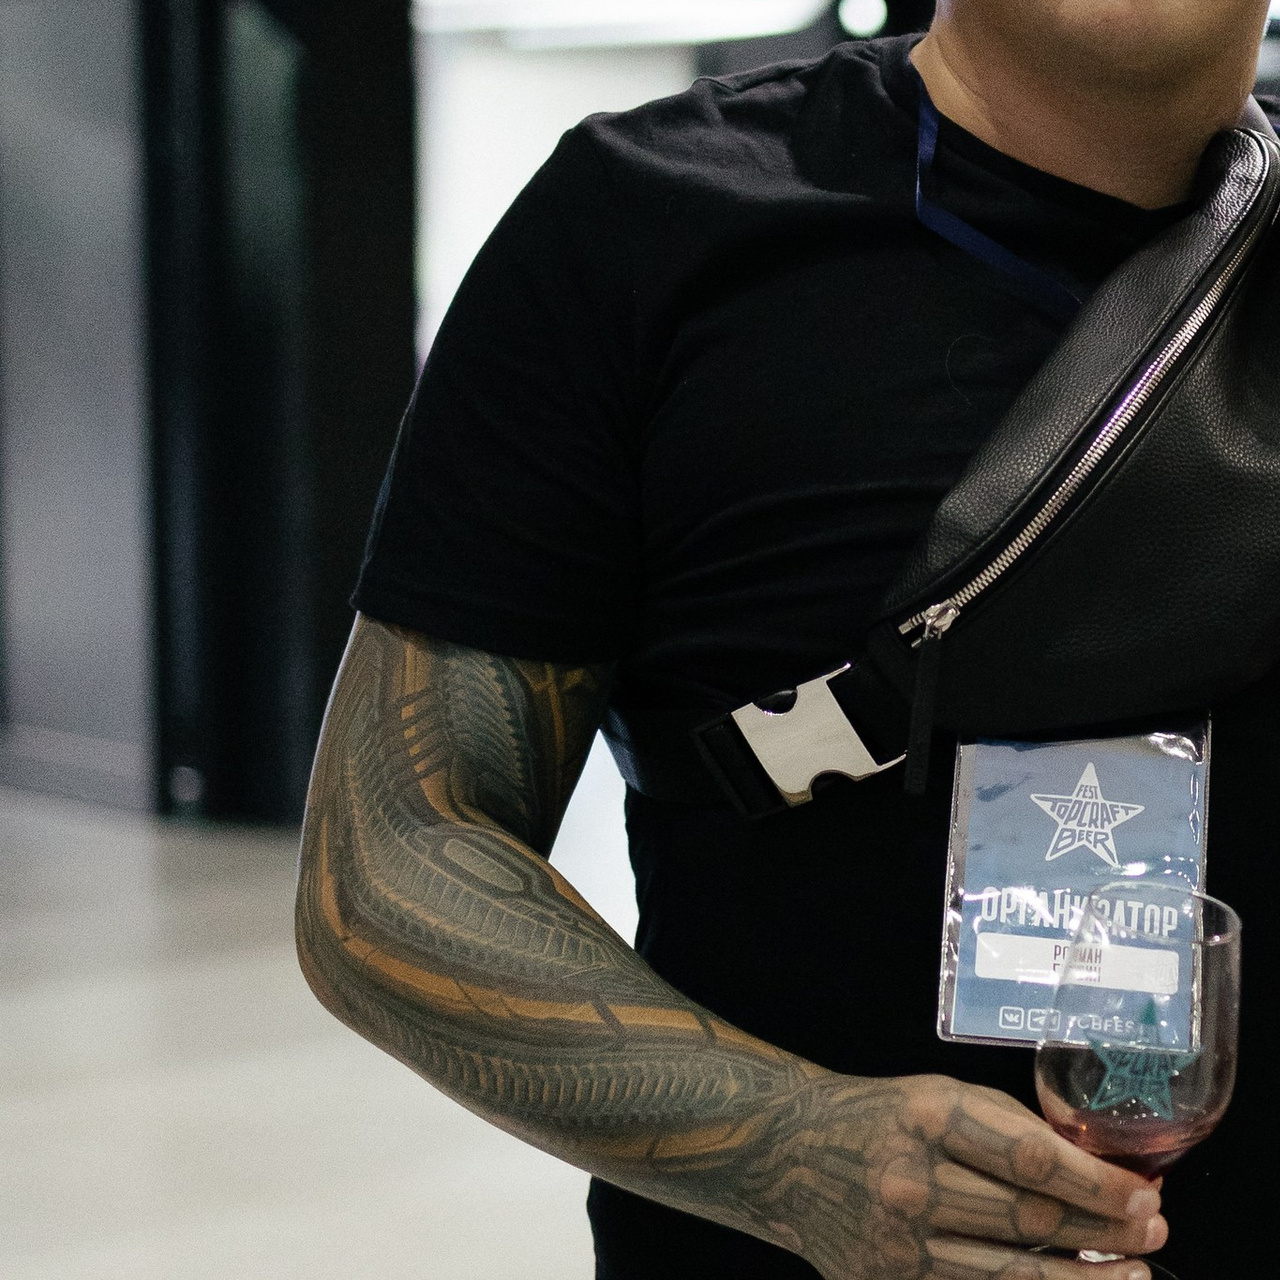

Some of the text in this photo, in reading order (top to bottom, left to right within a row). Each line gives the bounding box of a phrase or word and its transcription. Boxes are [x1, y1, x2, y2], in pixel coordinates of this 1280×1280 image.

[1076, 784, 1099, 800] FEST
[1034, 796, 1139, 829] TOPCRAFT
[1050, 827, 1116, 863] BEER
